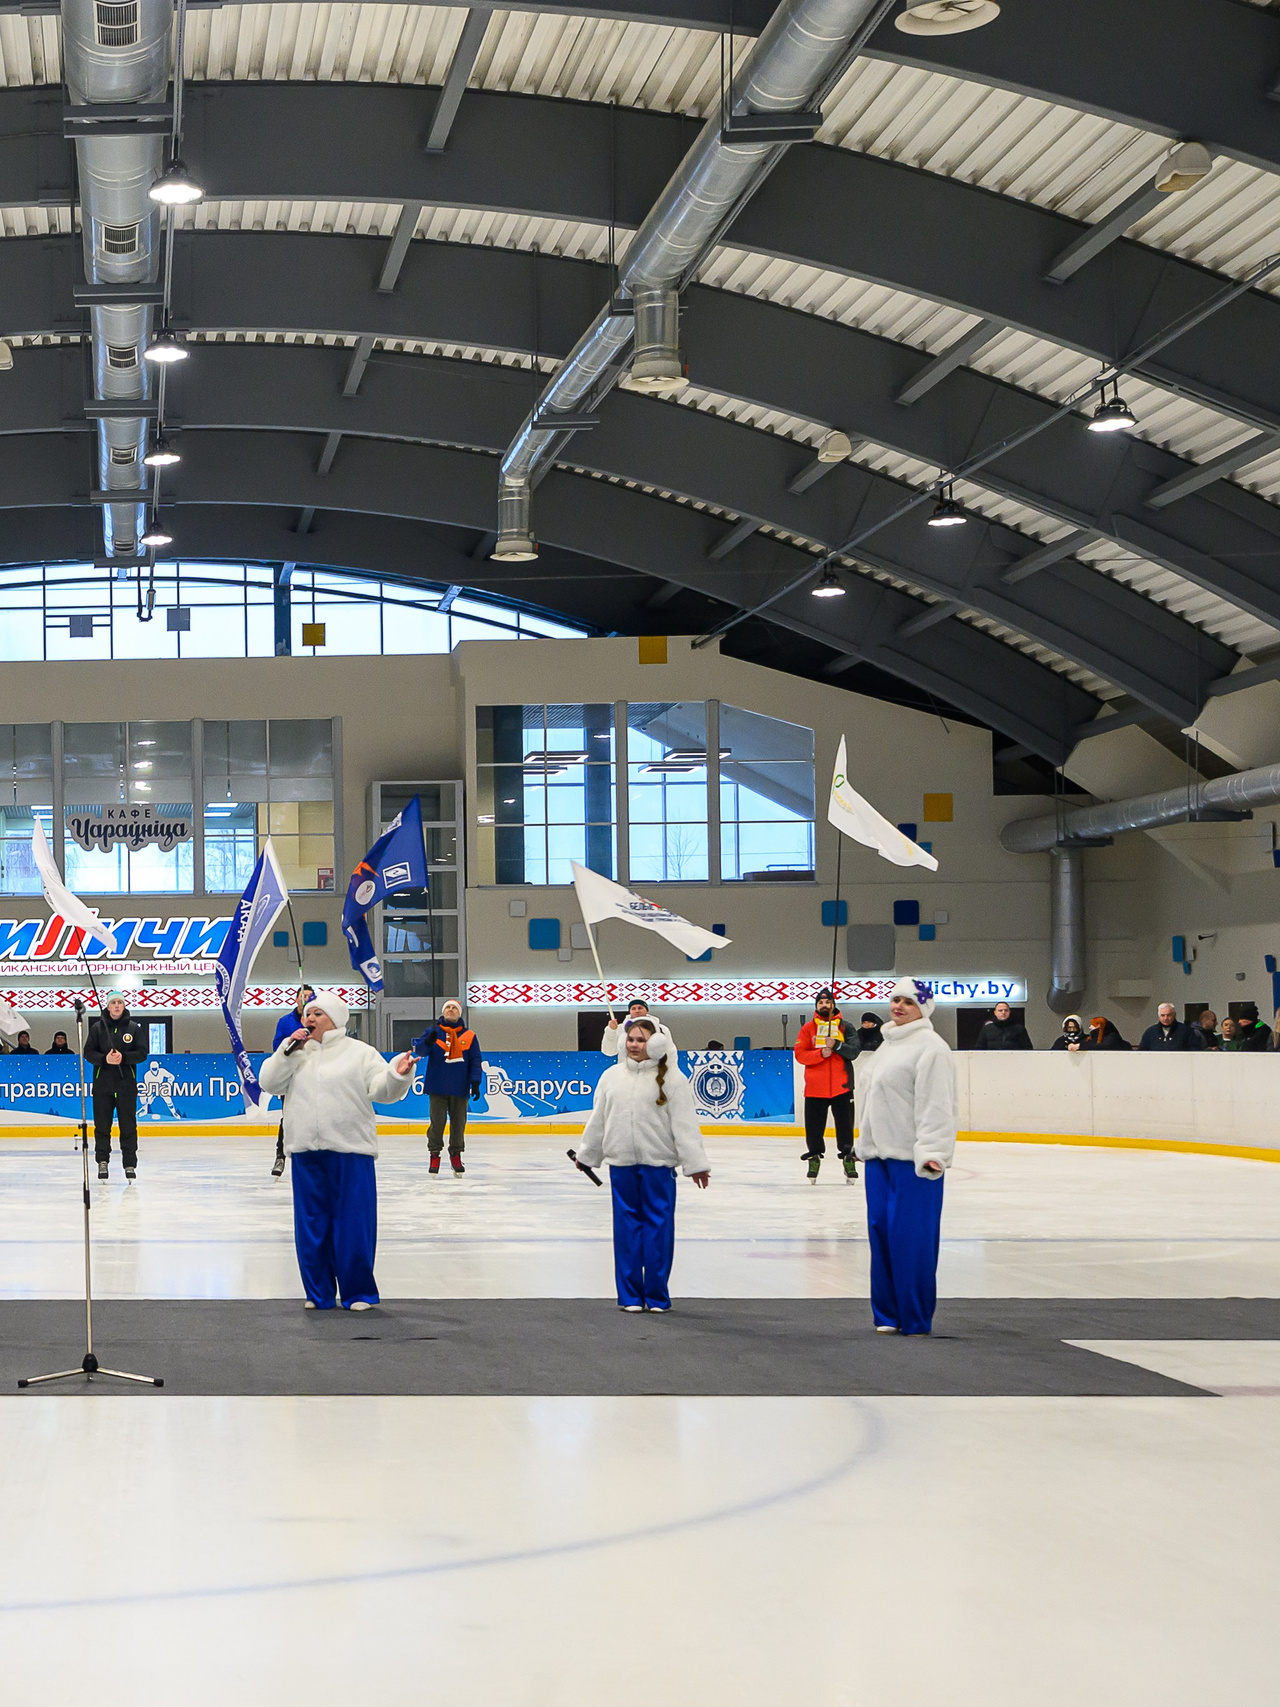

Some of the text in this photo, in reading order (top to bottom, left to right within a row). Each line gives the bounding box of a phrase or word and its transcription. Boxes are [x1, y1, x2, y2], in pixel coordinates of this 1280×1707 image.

[107, 809, 151, 818] КАФЕ
[71, 818, 188, 847] Чараўніца
[137, 1082, 203, 1098] елами
[486, 1075, 592, 1100] Беларусь
